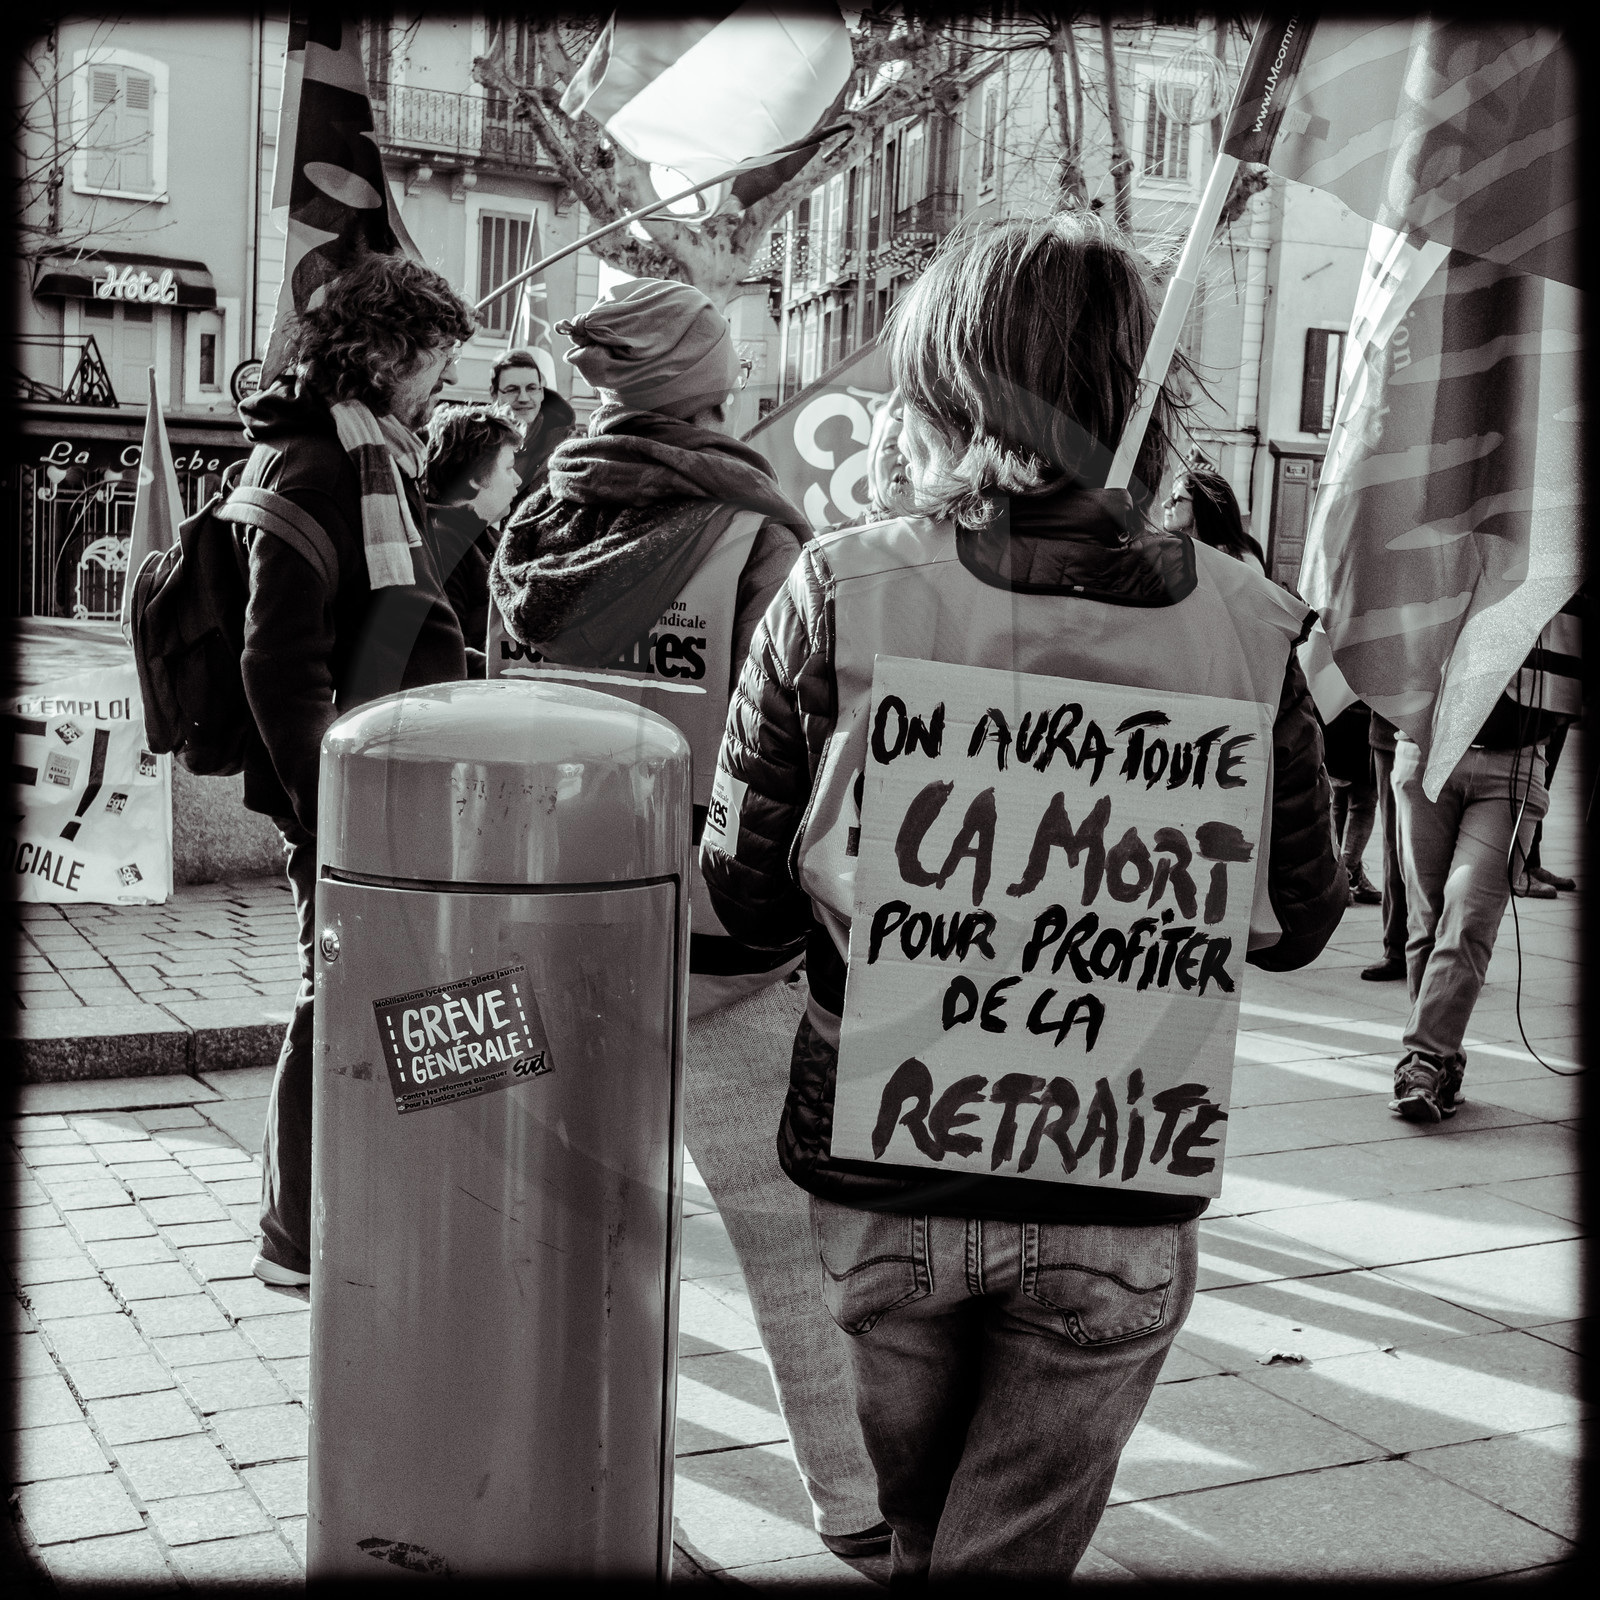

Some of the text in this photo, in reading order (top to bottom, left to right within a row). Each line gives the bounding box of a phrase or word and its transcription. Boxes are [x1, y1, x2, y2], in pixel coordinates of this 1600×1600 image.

[98, 264, 174, 305] Hôtel
[39, 441, 220, 471] La Cche
[660, 612, 707, 630] ndicale
[871, 694, 1257, 791] ON AURA TOUTE
[1005, 791, 1254, 925] MORT
[867, 899, 997, 965] POUR
[375, 964, 525, 1008] Mobilisations lycéennes, gilets jaunes
[402, 989, 511, 1053] GRÈVE
[942, 975, 1106, 1054] DE LA
[411, 1032, 524, 1084] GÉNÉRALE
[402, 1070, 508, 1102] Contre les réformes Blanquer
[404, 1085, 484, 1110] Pour la justice sociale
